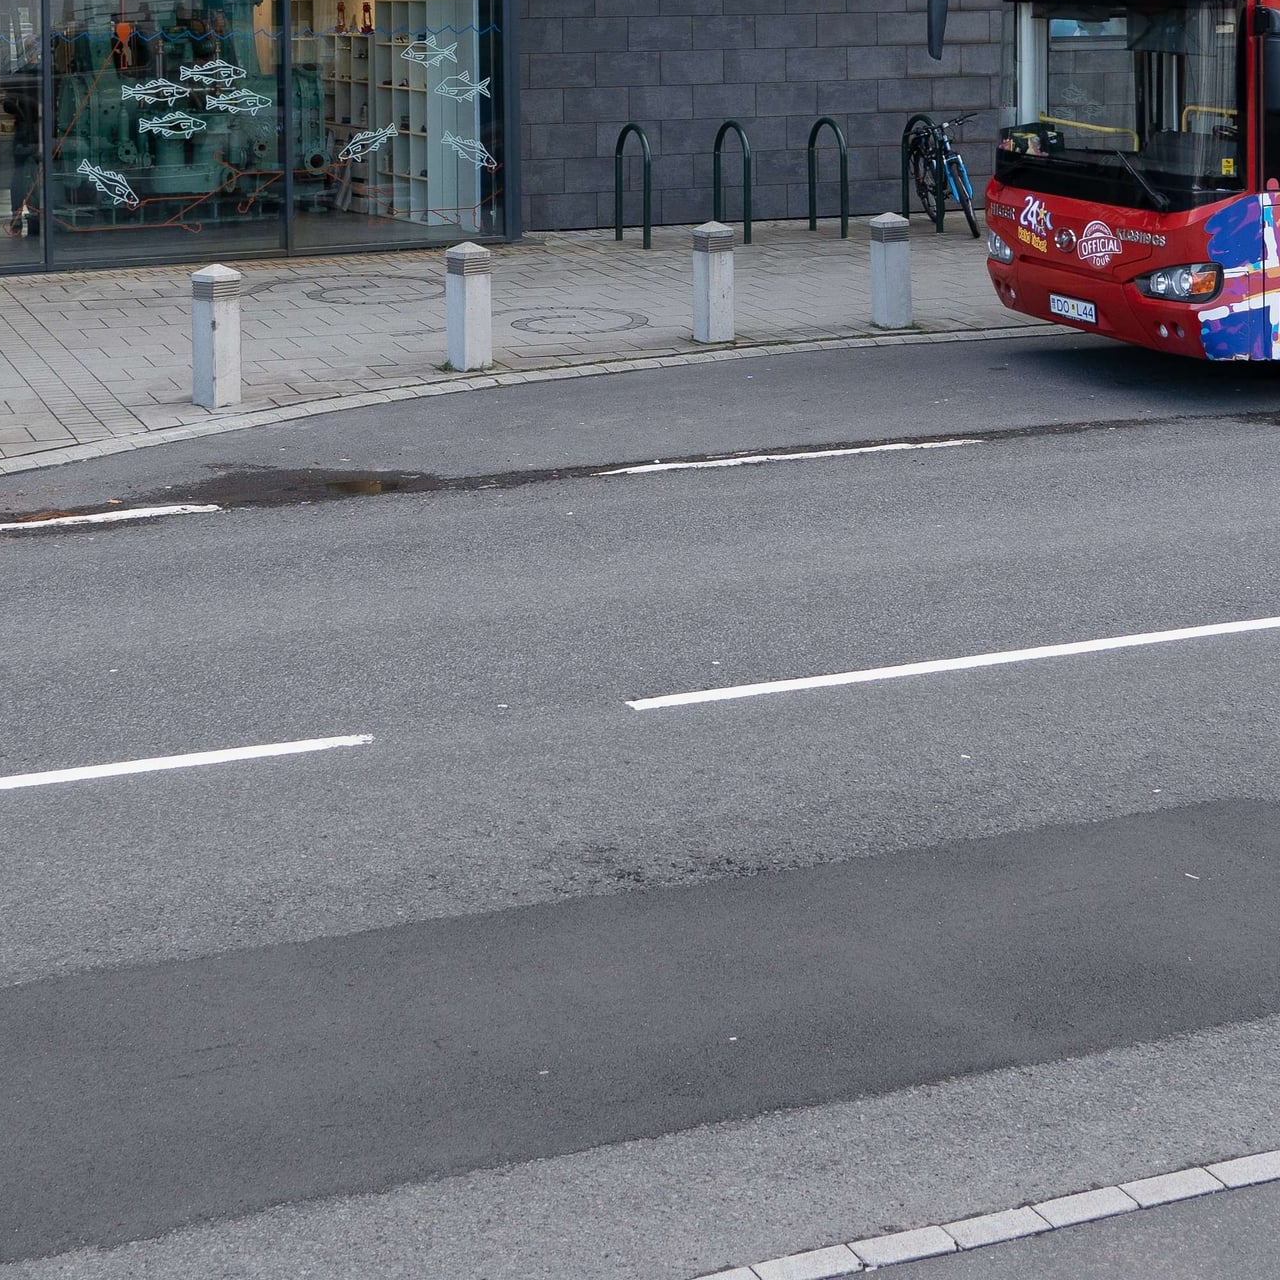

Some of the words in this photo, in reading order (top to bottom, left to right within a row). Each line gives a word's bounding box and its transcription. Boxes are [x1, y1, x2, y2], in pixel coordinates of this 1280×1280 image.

[1020, 195, 1040, 229] 24
[1081, 236, 1120, 257] OFFICIAL
[1092, 254, 1111, 266] TOUR
[1076, 303, 1094, 320] L44
